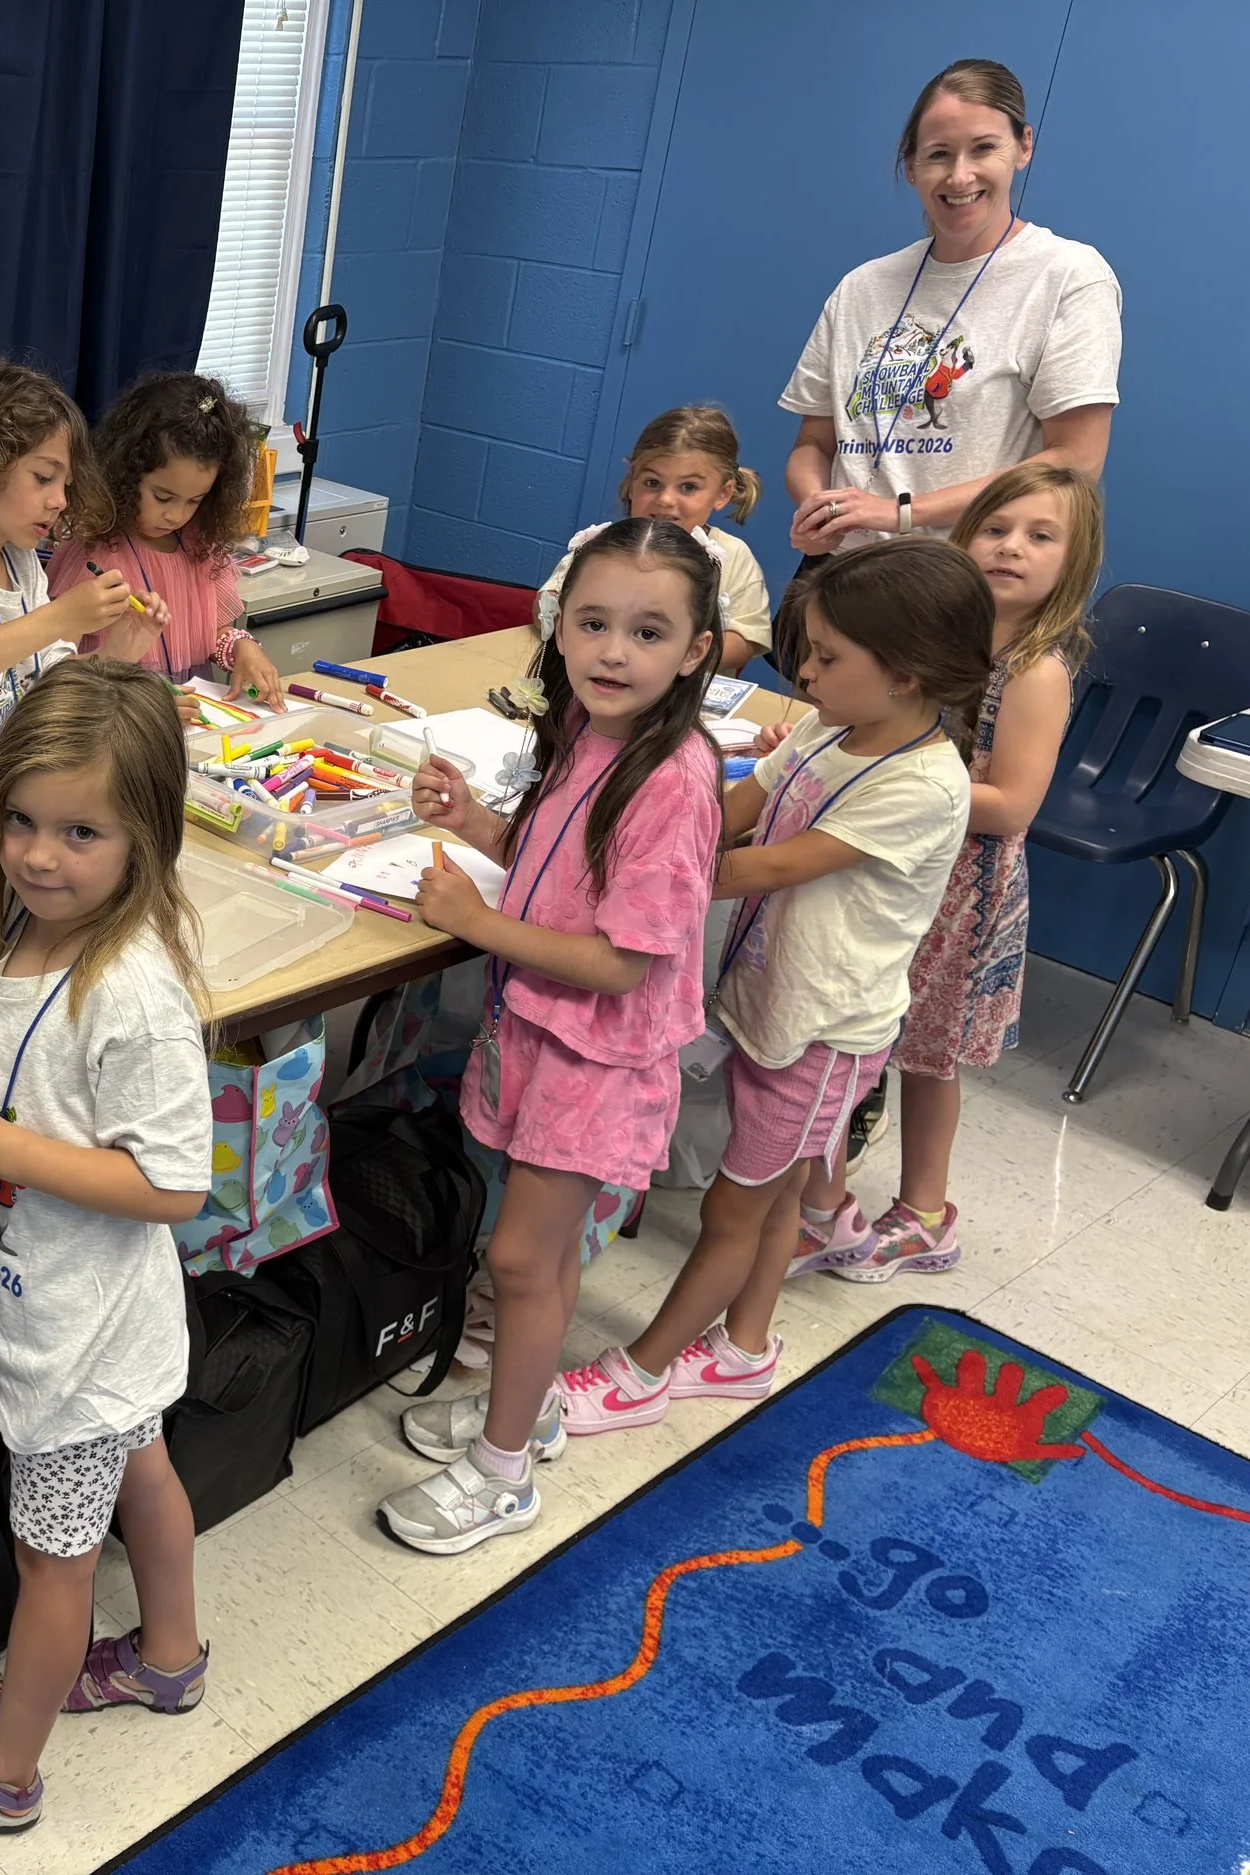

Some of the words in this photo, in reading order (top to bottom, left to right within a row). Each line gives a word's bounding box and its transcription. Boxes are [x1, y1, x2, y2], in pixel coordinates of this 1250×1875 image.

[862, 359, 931, 385] SNOWBALL
[854, 388, 925, 416] CHALLENGE
[860, 376, 926, 400] MOUNTAIN
[838, 438, 879, 457] Trinity
[918, 437, 954, 455] 2026
[375, 1321, 399, 1358] F
[400, 1312, 415, 1336] &
[418, 1295, 439, 1333] F
[838, 1537, 989, 1618] go
[872, 1648, 1139, 1811] and
